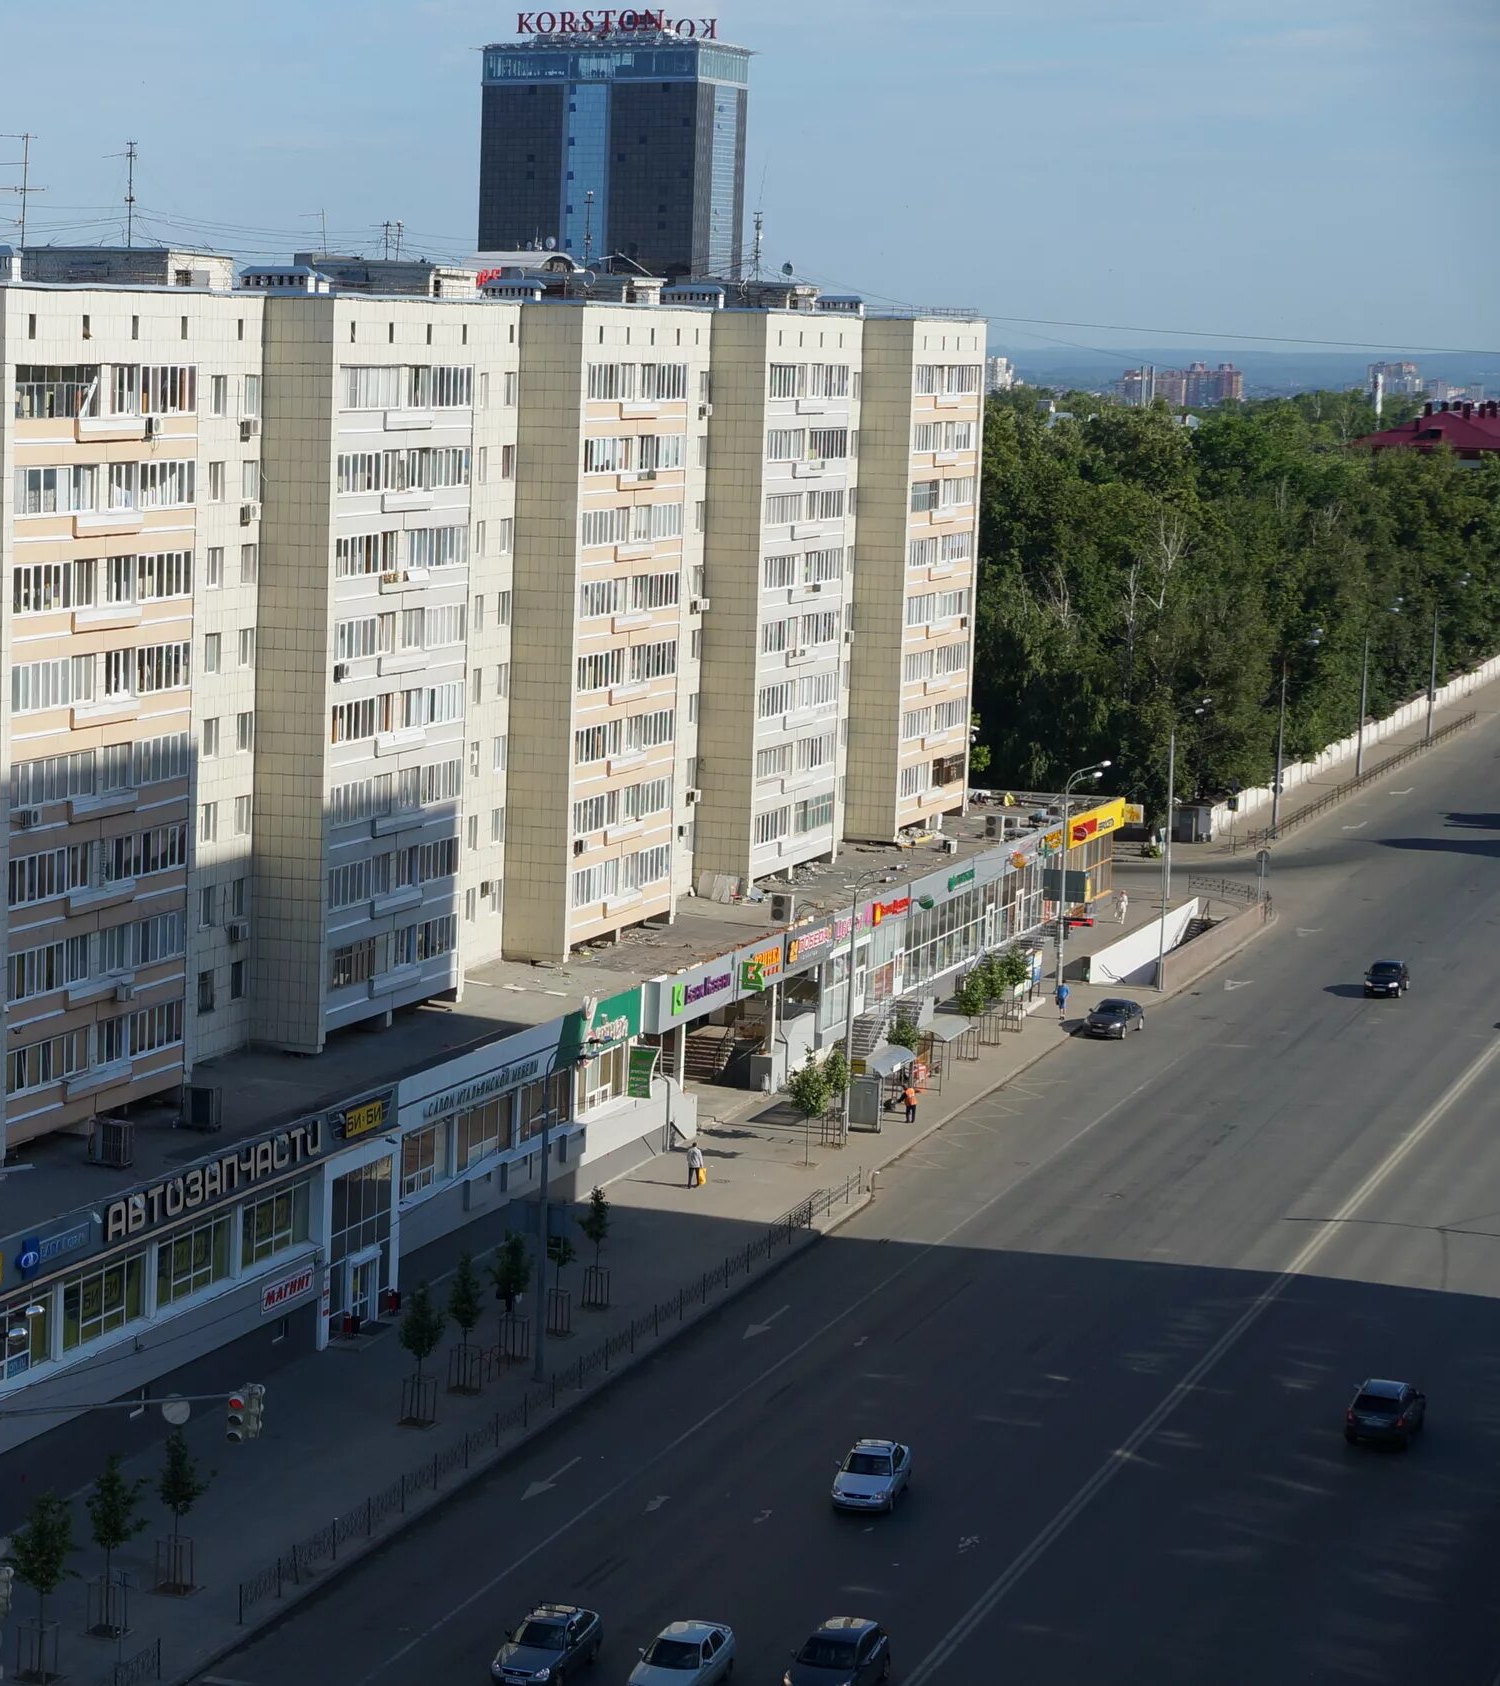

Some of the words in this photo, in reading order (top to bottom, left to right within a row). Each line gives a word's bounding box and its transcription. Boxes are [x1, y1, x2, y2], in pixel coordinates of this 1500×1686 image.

[516, 9, 665, 34] KORSTON
[106, 1119, 323, 1241] АВТОЗАПЧАСТИ
[264, 1272, 312, 1307] МАГНИТ
